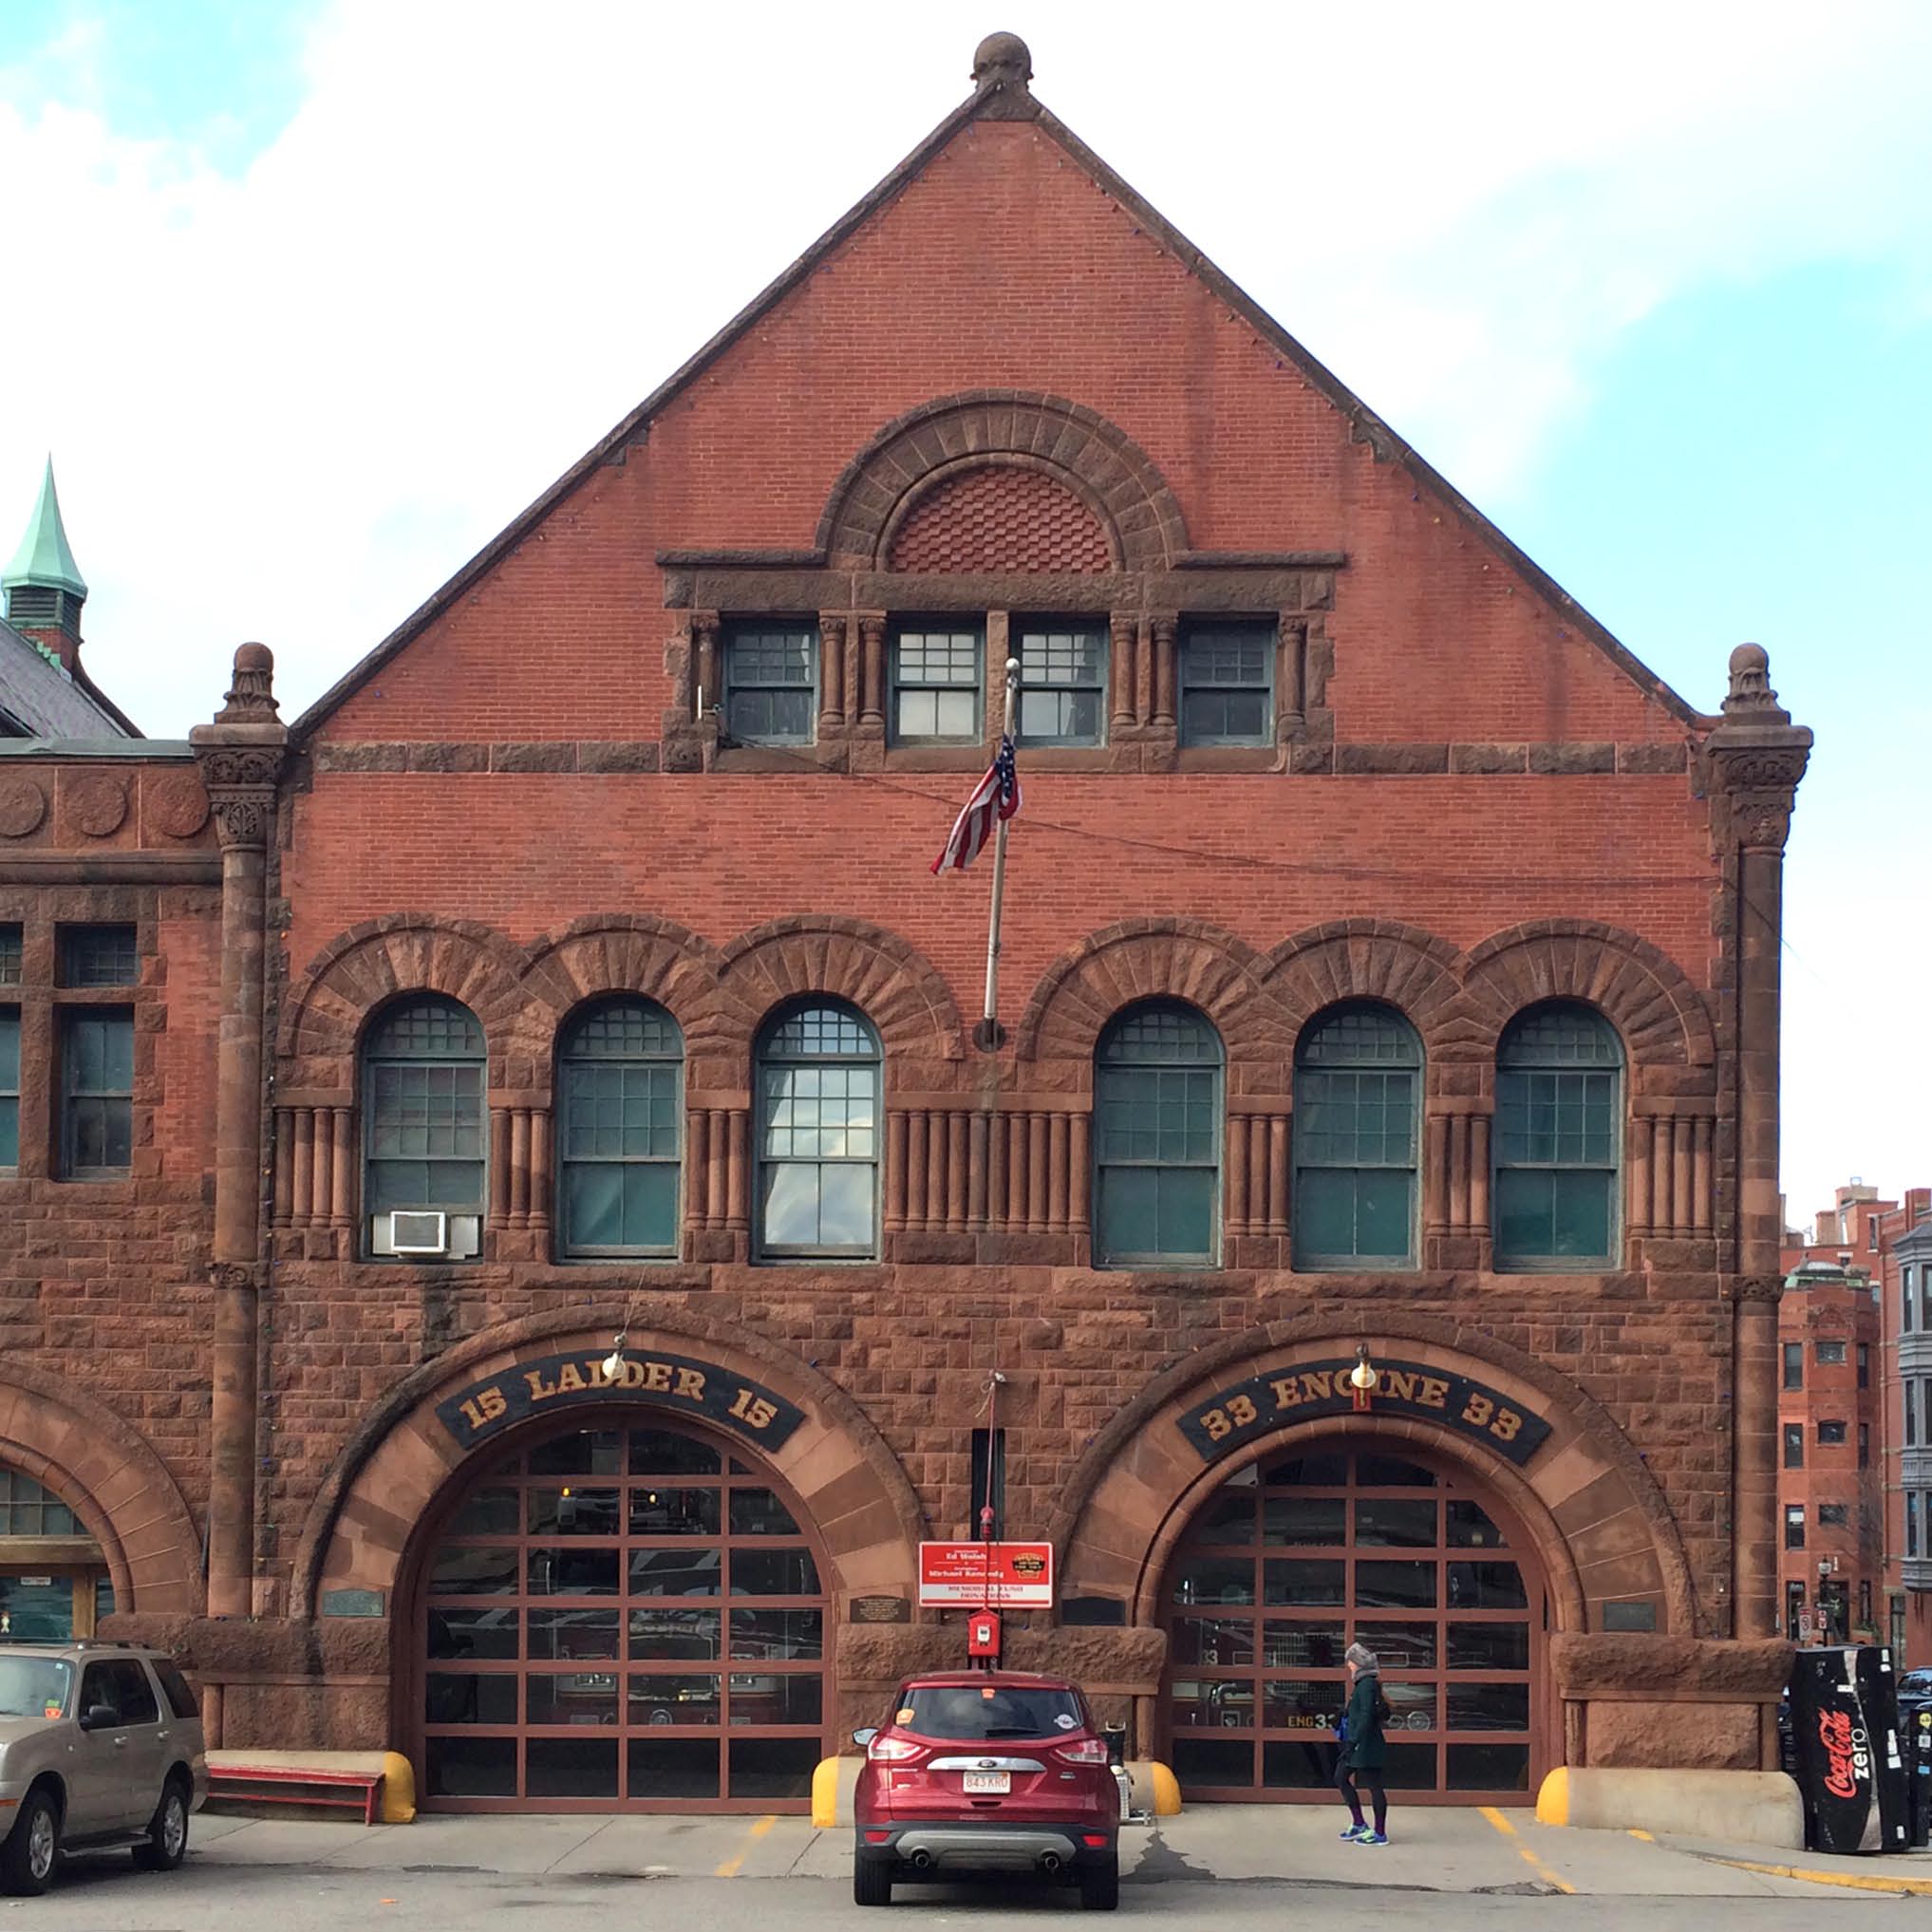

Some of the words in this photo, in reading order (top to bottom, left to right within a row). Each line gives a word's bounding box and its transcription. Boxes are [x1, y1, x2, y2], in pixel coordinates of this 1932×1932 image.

[459, 1386, 507, 1430] 15
[523, 1360, 706, 1402] LADDER
[728, 1388, 778, 1429] 15
[1199, 1394, 1258, 1441] 33
[1269, 1368, 1450, 1410] ENGINE
[1461, 1392, 1523, 1440] 33
[1851, 1728, 1870, 1779] zero
